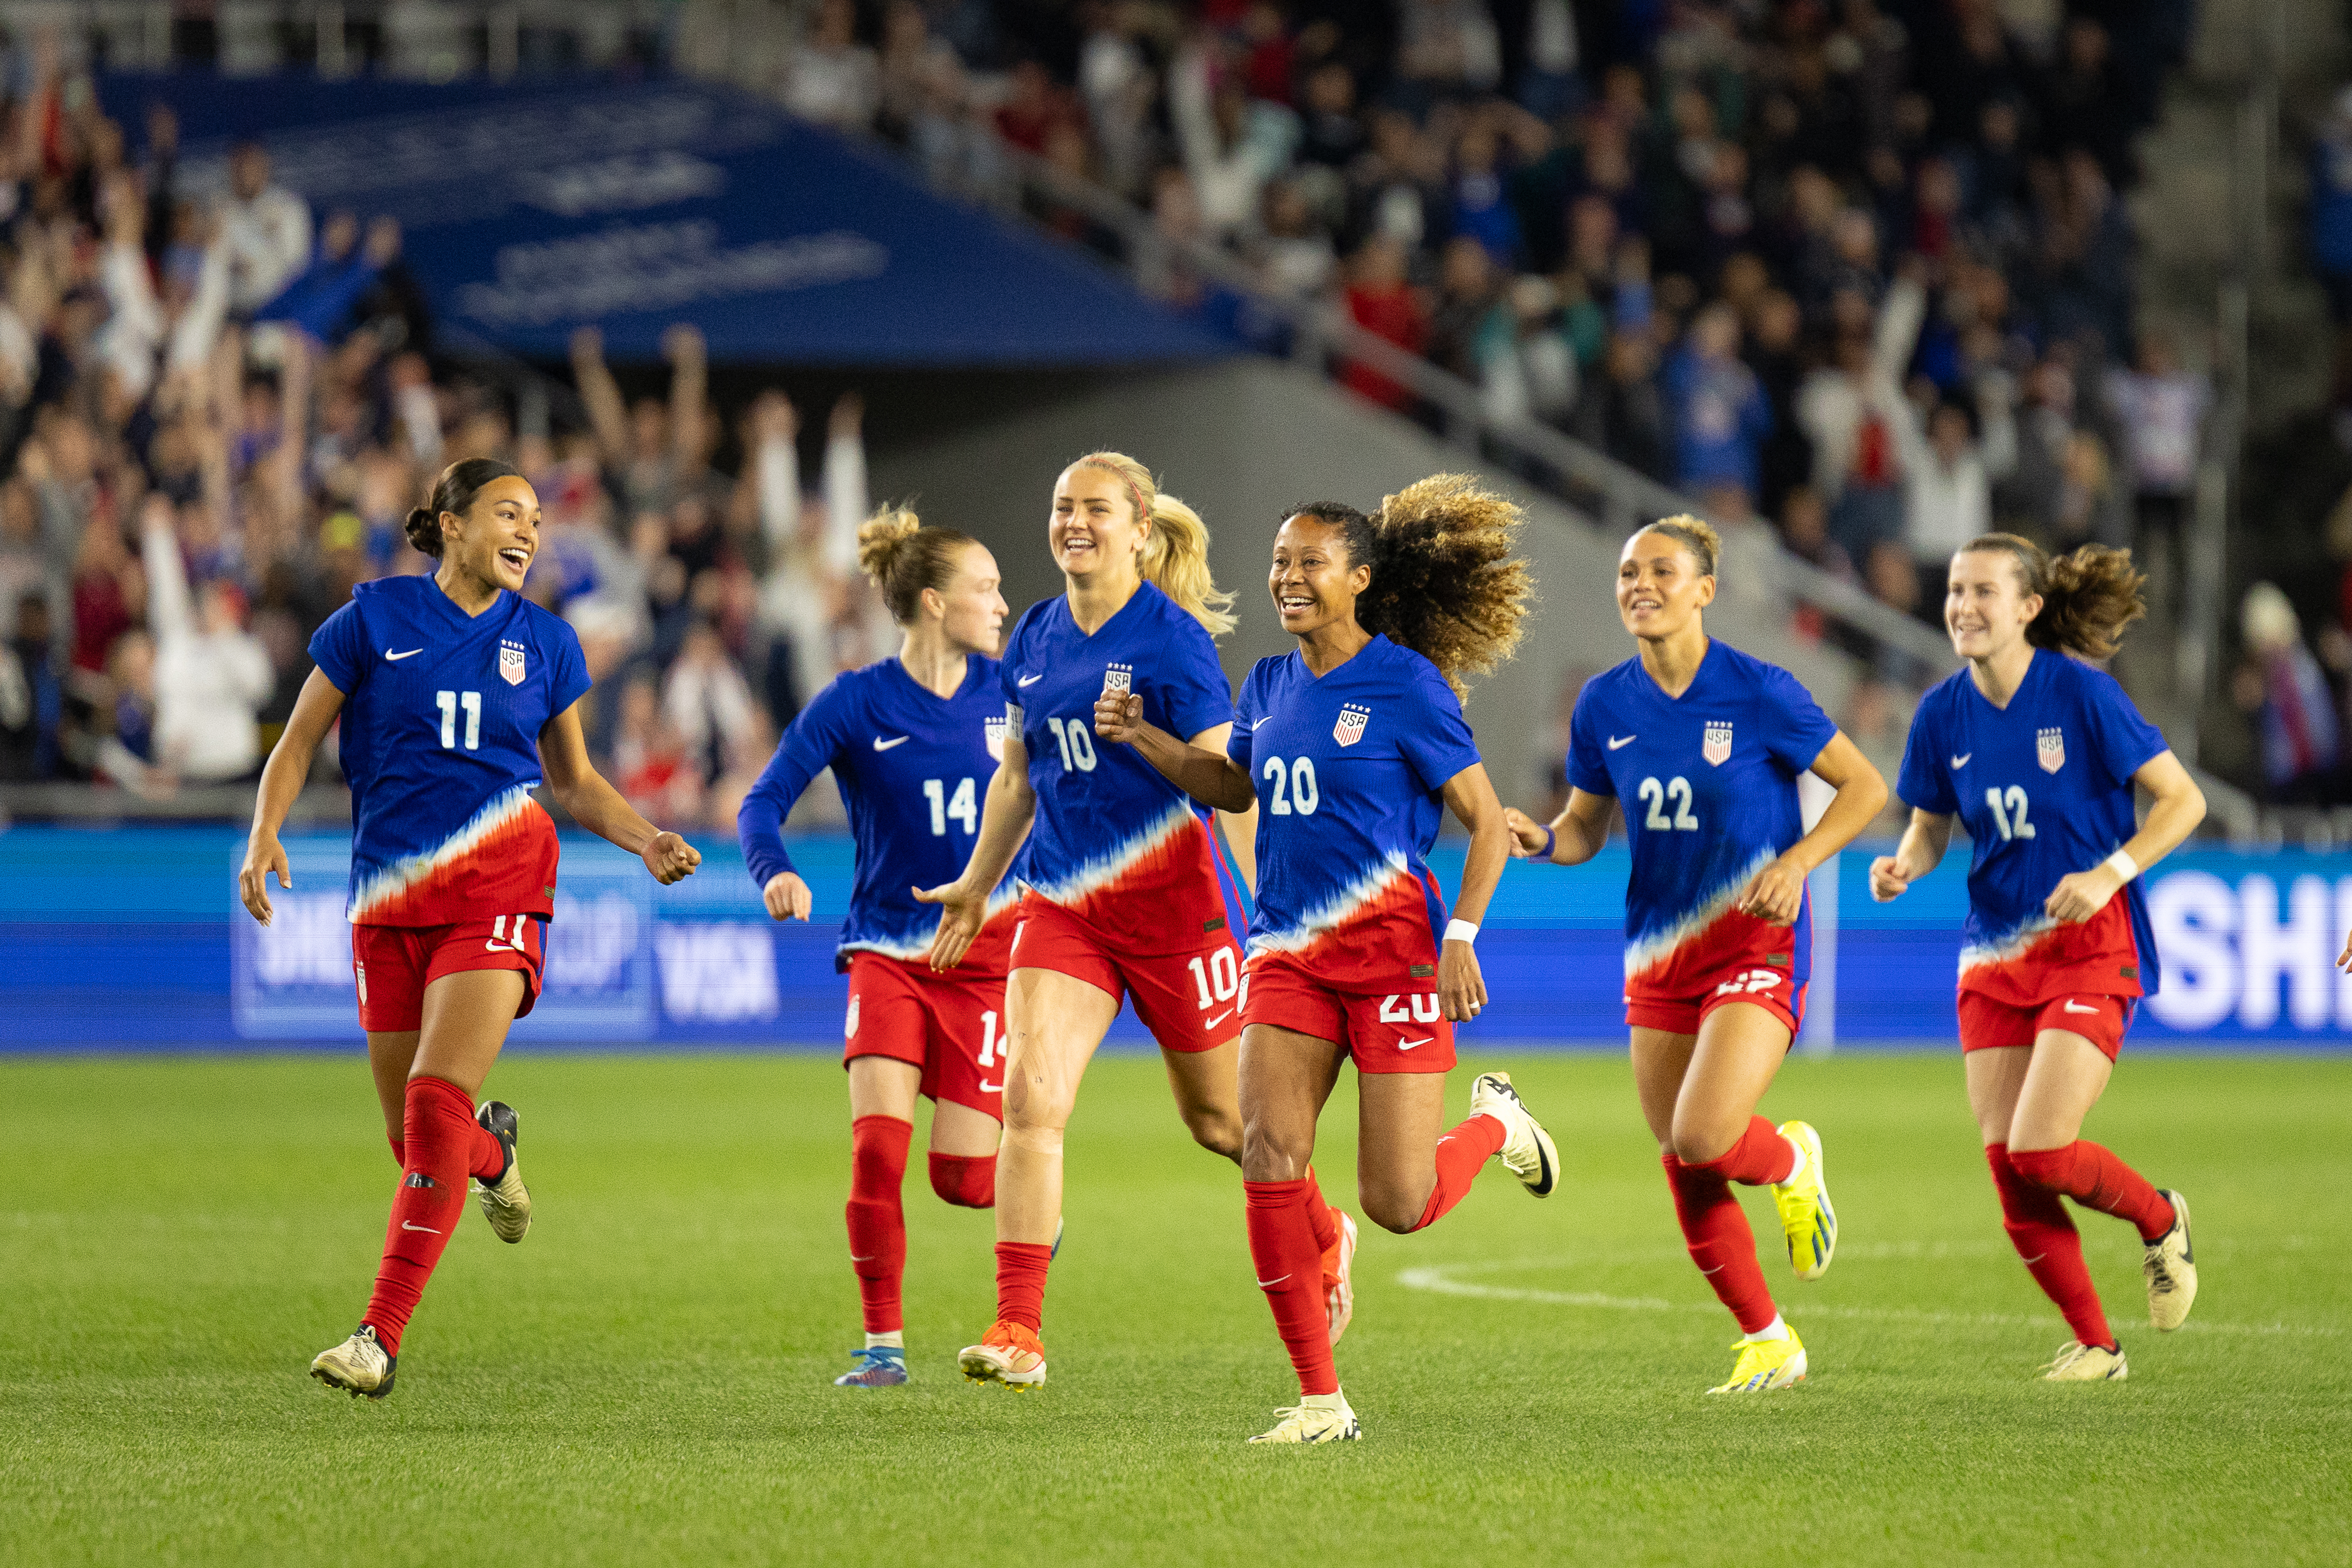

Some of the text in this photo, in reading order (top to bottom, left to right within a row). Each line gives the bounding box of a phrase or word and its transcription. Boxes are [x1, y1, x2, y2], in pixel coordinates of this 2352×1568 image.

[501, 649, 523, 665] USA
[1107, 673, 1129, 687] USA
[436, 690, 481, 750] 11
[1048, 717, 1097, 772] 10
[1341, 712, 1365, 726] USA
[1708, 730, 1730, 744] USA
[2040, 736, 2062, 751] USA
[923, 777, 977, 836] 14
[1263, 756, 1319, 815] 20
[1638, 776, 1698, 832] 22
[1986, 784, 2036, 842] 12
[1188, 946, 1238, 1010] 10
[2145, 872, 2352, 1030] SH
